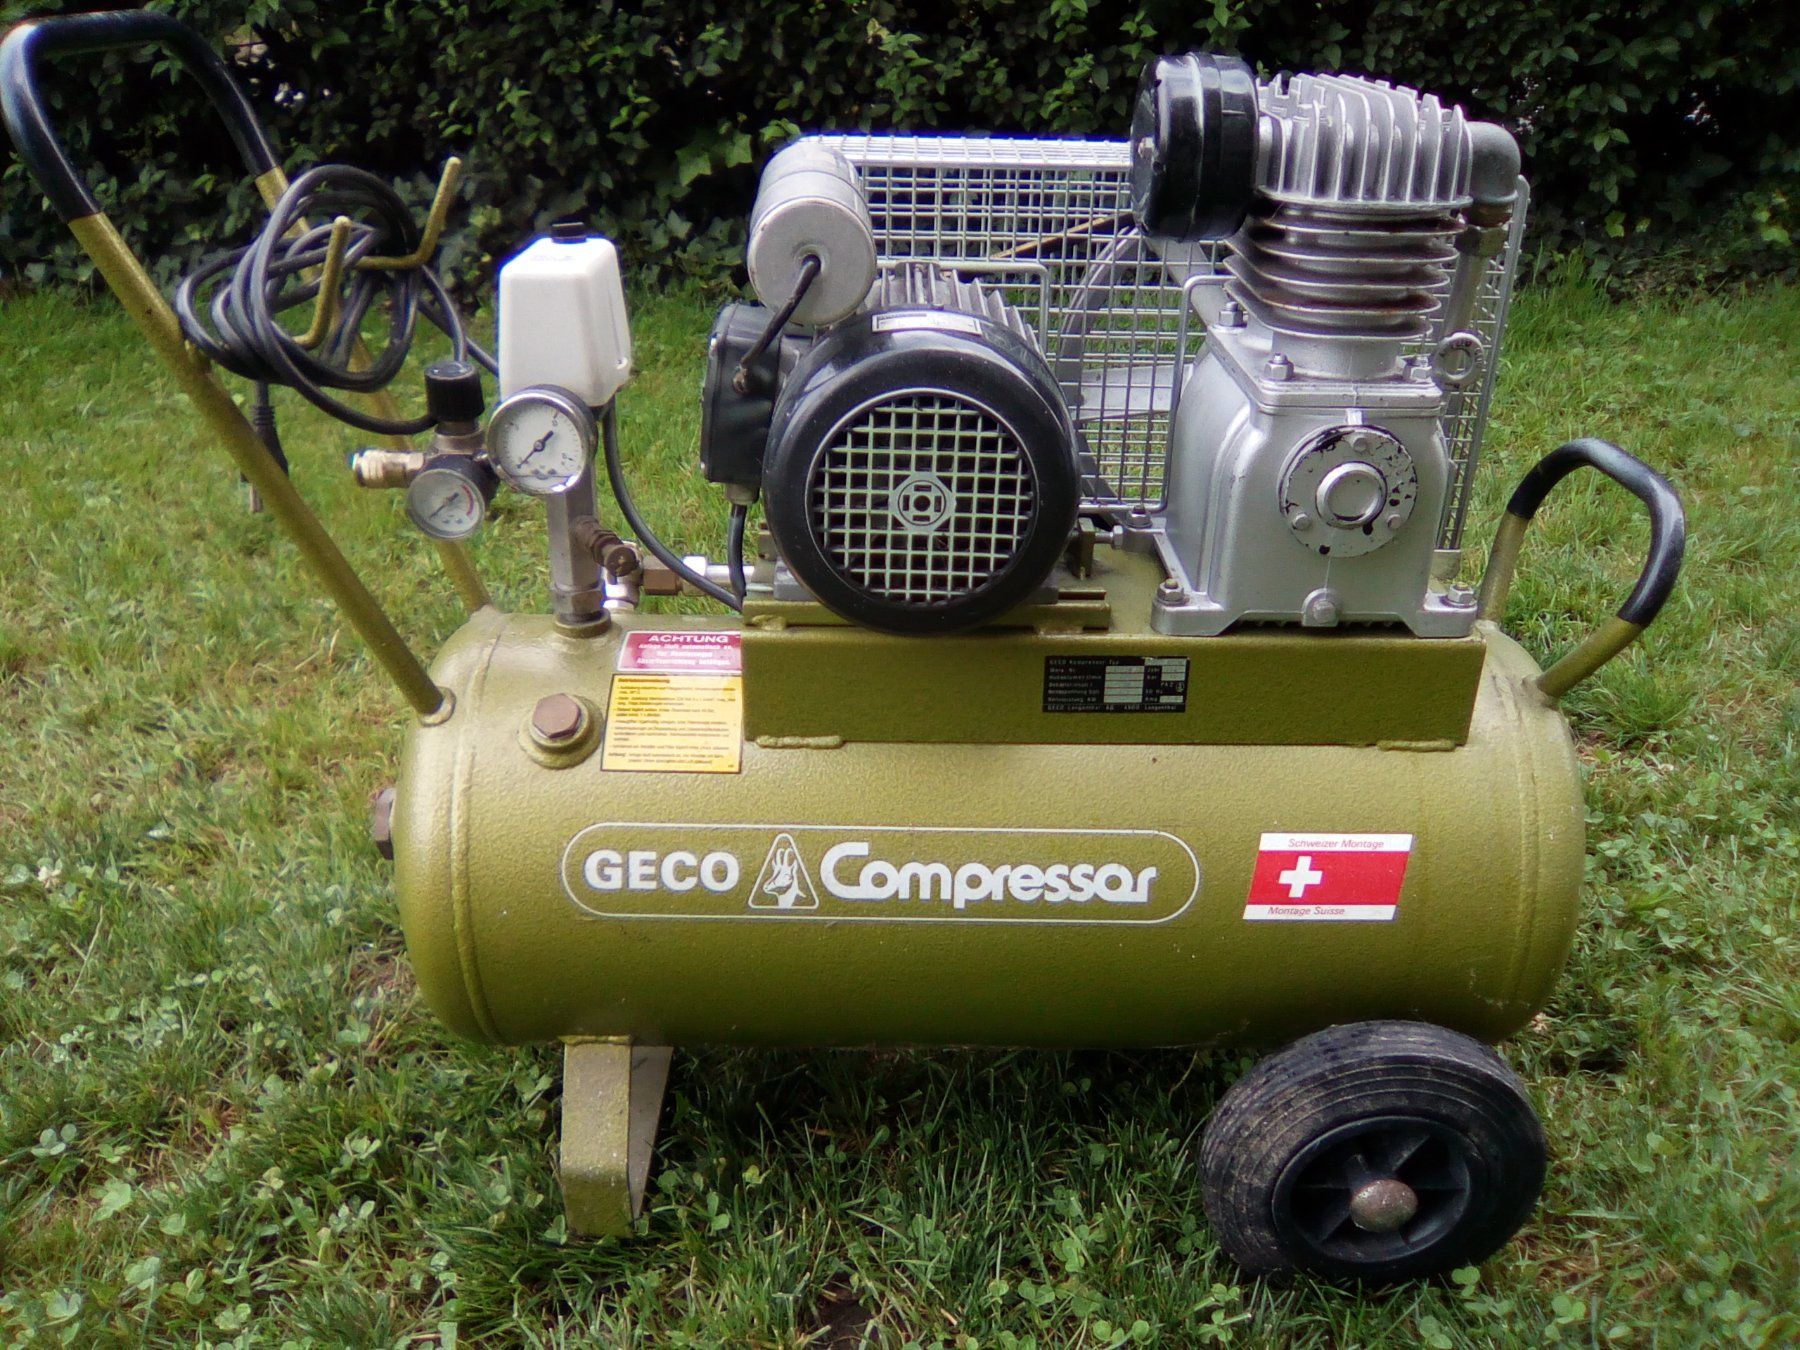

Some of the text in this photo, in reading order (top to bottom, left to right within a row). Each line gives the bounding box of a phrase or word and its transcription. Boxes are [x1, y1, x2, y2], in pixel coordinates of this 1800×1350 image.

[648, 634, 729, 644] ACHTUNG
[1288, 838, 1384, 849] Schweizer Montage
[583, 850, 740, 893] GECO
[1268, 904, 1345, 916] Montage Suisse
